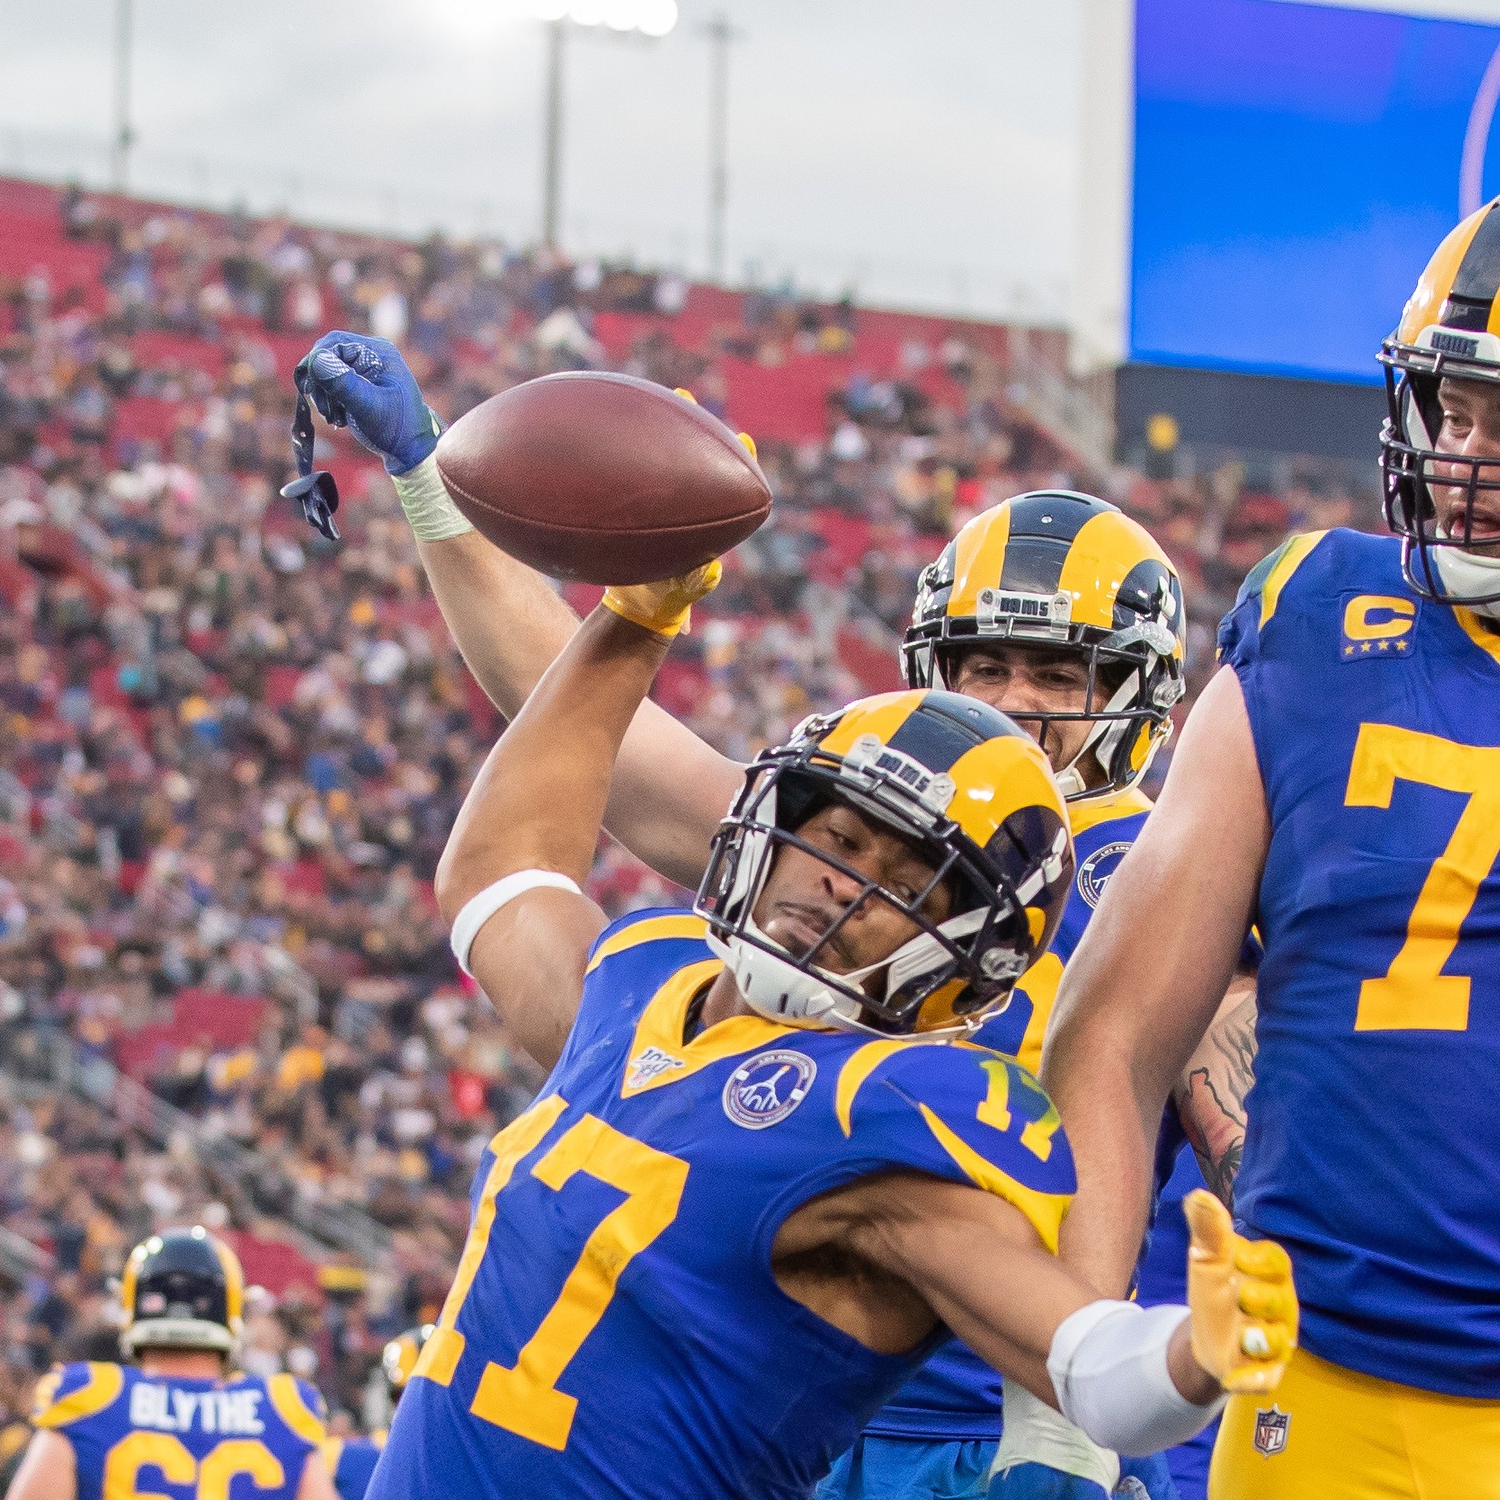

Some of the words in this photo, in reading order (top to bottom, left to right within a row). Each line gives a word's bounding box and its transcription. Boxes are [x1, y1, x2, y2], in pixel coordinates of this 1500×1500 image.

[1344, 594, 1416, 640] C
[976, 1060, 1061, 1163] 17
[412, 1094, 690, 1451] 17
[130, 1381, 265, 1436] BLYTHE
[1258, 1427, 1281, 1448] NFL
